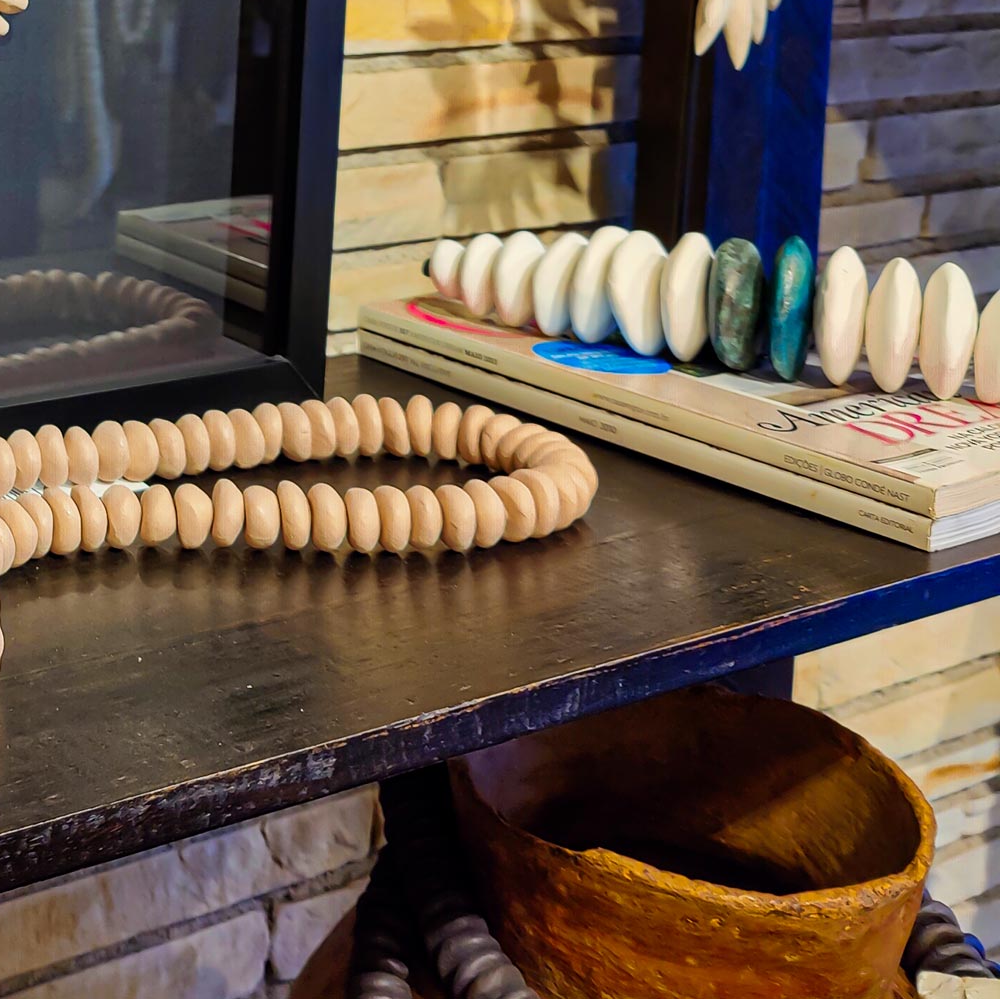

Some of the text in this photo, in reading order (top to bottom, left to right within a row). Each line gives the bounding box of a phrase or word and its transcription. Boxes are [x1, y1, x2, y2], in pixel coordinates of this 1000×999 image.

[757, 392, 962, 433] America
[783, 454, 910, 502] EDIÇÕES GLOBO CONDÉ NAST
